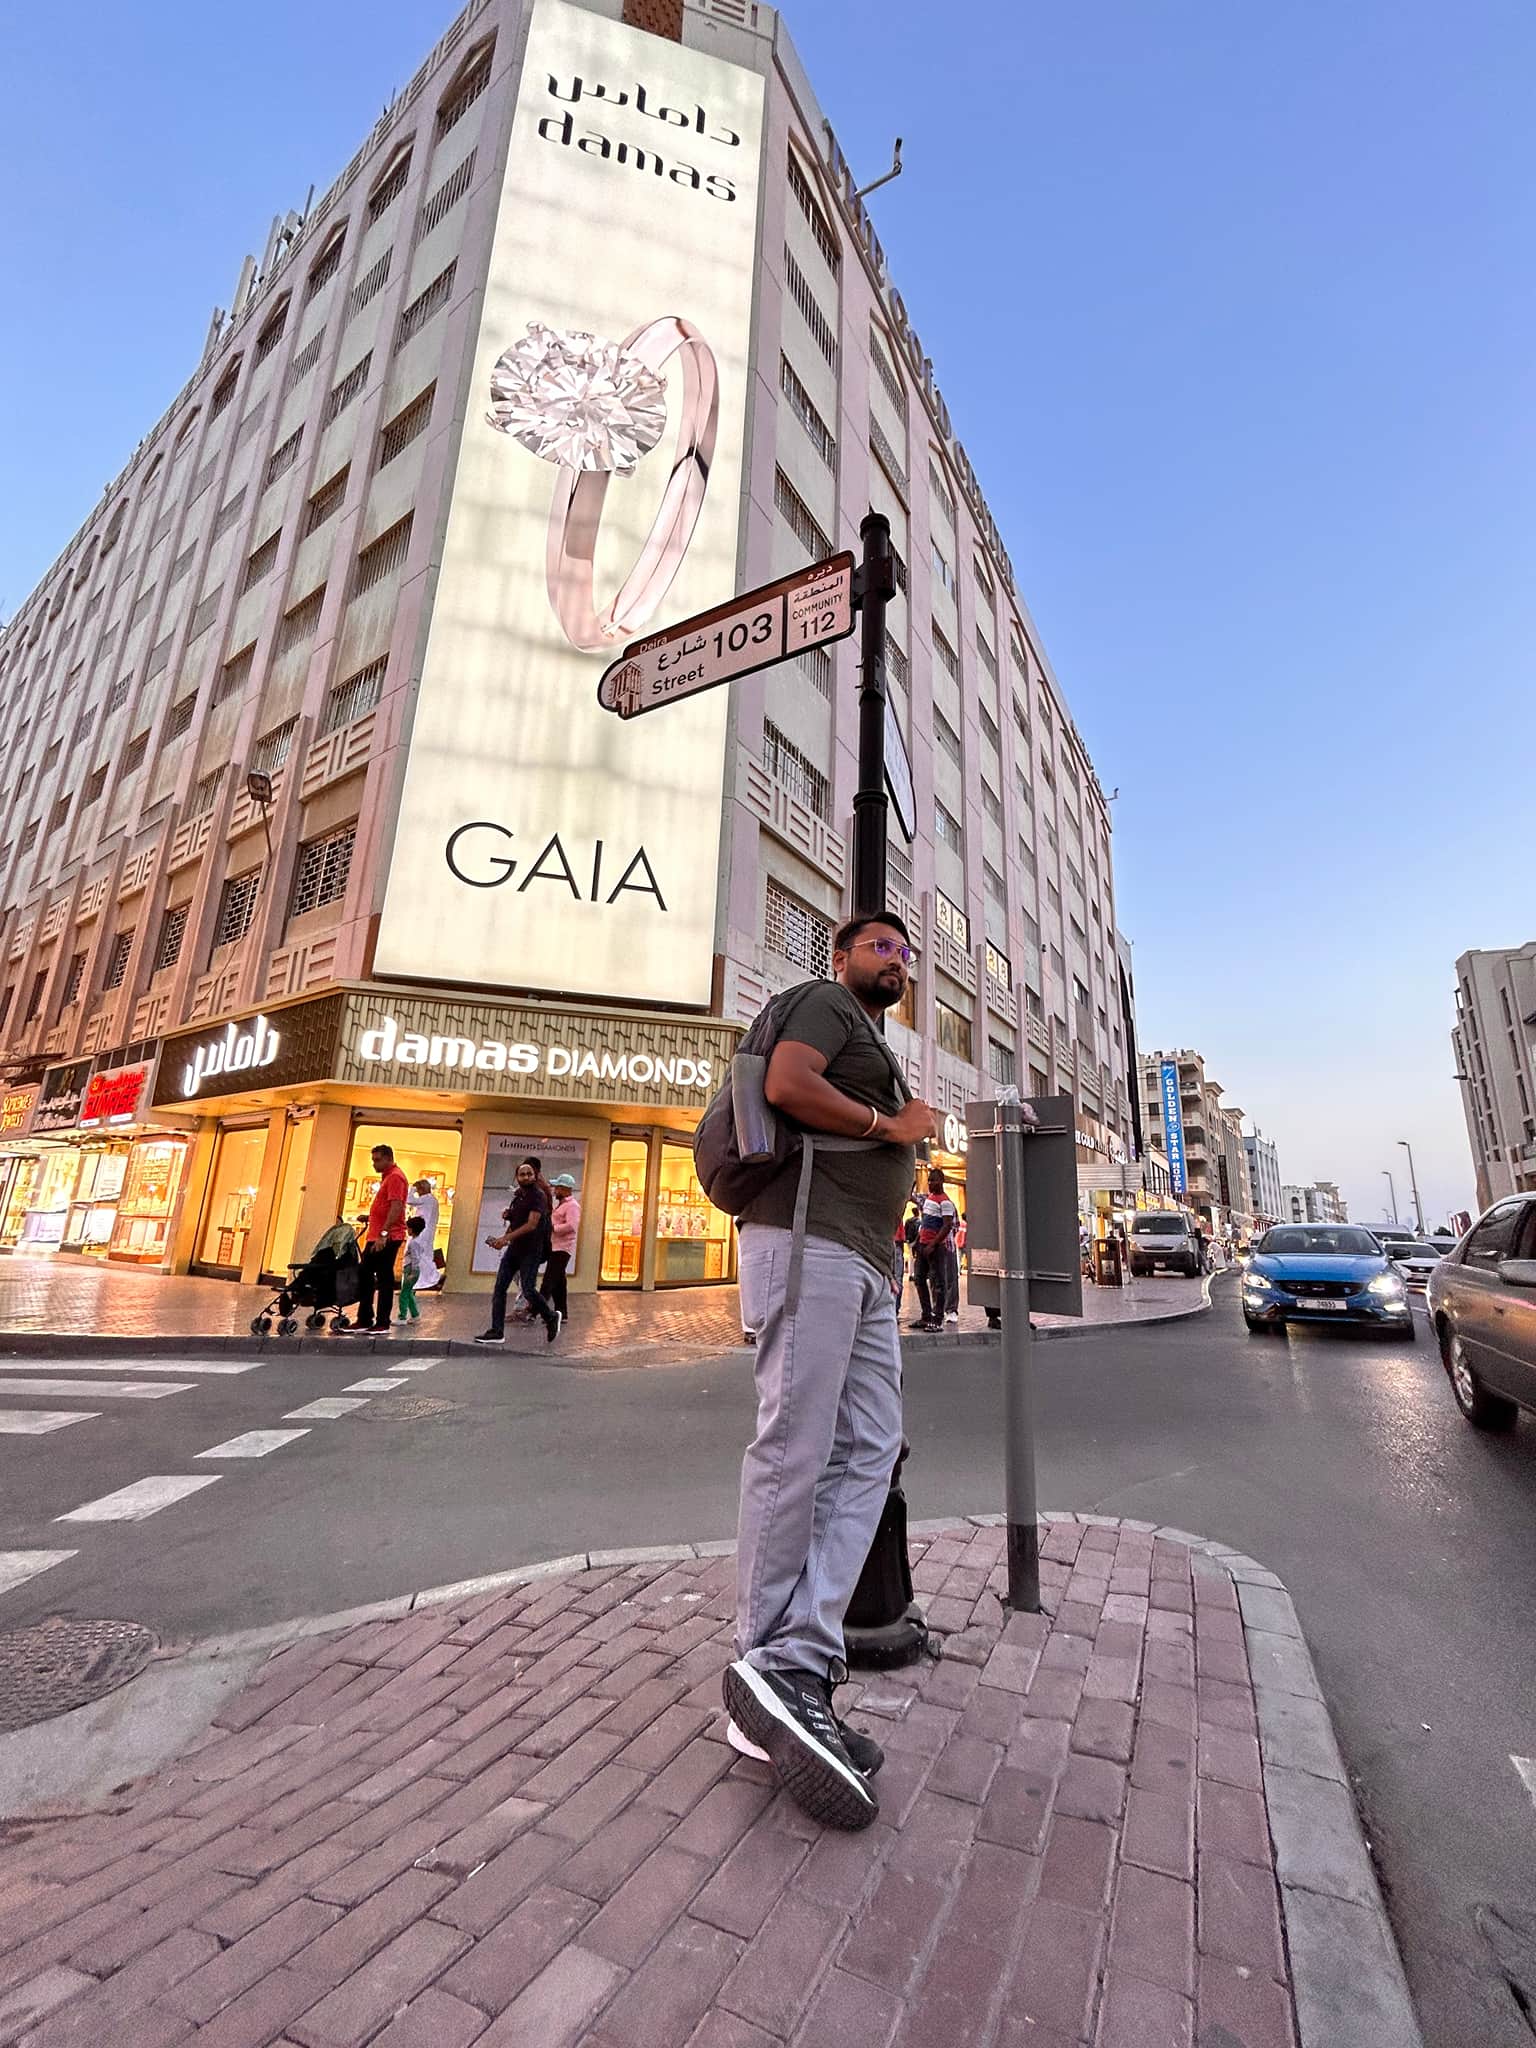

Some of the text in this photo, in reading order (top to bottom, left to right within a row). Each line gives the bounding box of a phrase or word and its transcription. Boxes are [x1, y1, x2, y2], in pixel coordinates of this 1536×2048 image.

[547, 73, 740, 146] داماس
[537, 109, 736, 202] damas
[794, 575, 843, 603] المنطقة
[792, 593, 843, 620] COMMUNITY
[800, 611, 835, 639] 112
[640, 636, 668, 654] Deira
[657, 613, 773, 671] شارع 103
[651, 663, 704, 695] Street
[446, 821, 668, 911] GAIA
[183, 1014, 280, 1097] داماس
[360, 1016, 713, 1088] damas DIAMONDS
[81, 1086, 140, 1120] SUNRISE
[1165, 1078, 1177, 1122] GOLDEN
[500, 1138, 536, 1150] damas
[1081, 1132, 1095, 1149] GOLD
[1170, 1132, 1180, 1160] STAR
[1172, 1161, 1182, 1193] HOTEL
